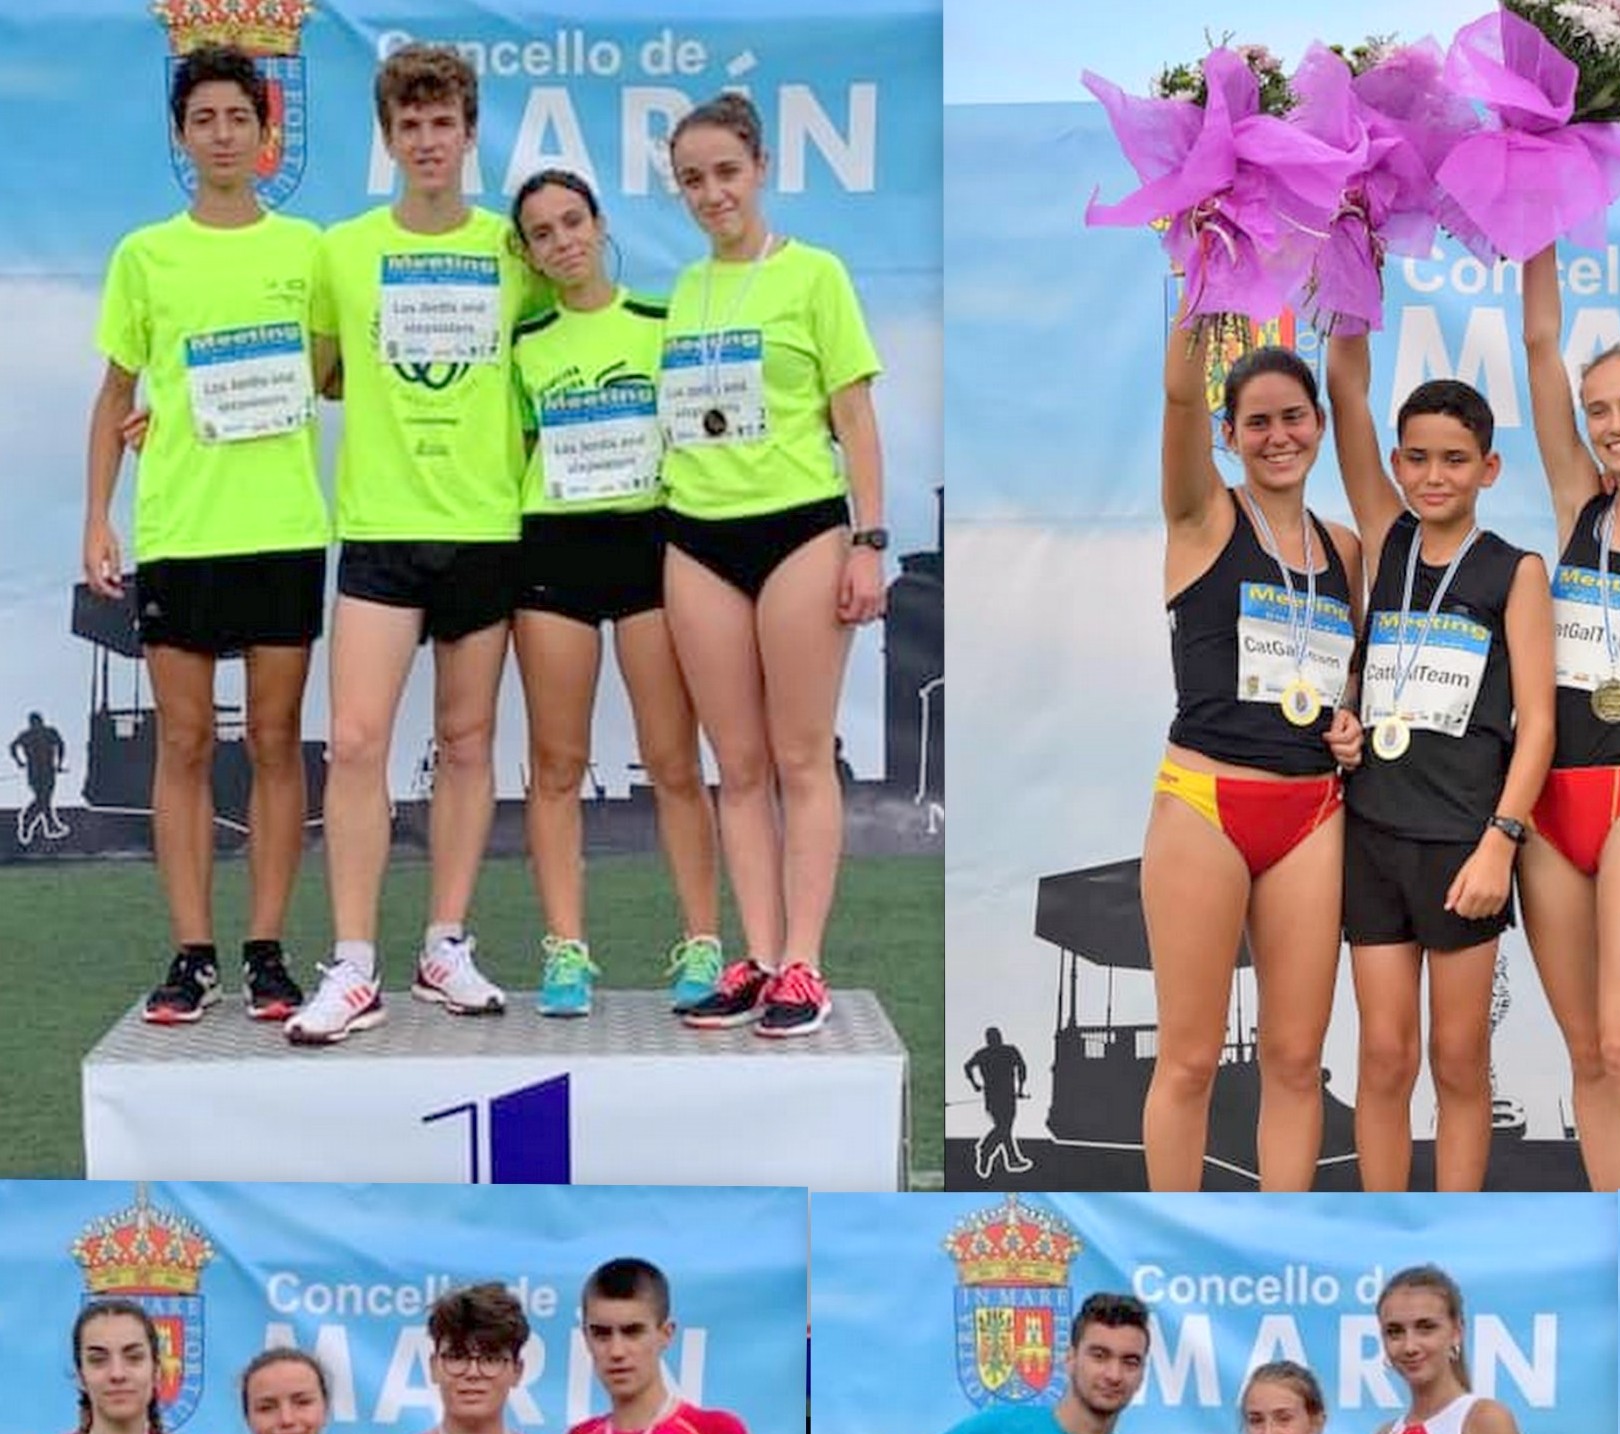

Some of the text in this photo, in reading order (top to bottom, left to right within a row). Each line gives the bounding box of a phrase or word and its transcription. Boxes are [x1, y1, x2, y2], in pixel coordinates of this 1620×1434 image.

[641, 30, 707, 76] de
[1132, 1264, 1340, 1305] Concello
[1132, 1311, 1557, 1409] MARN
